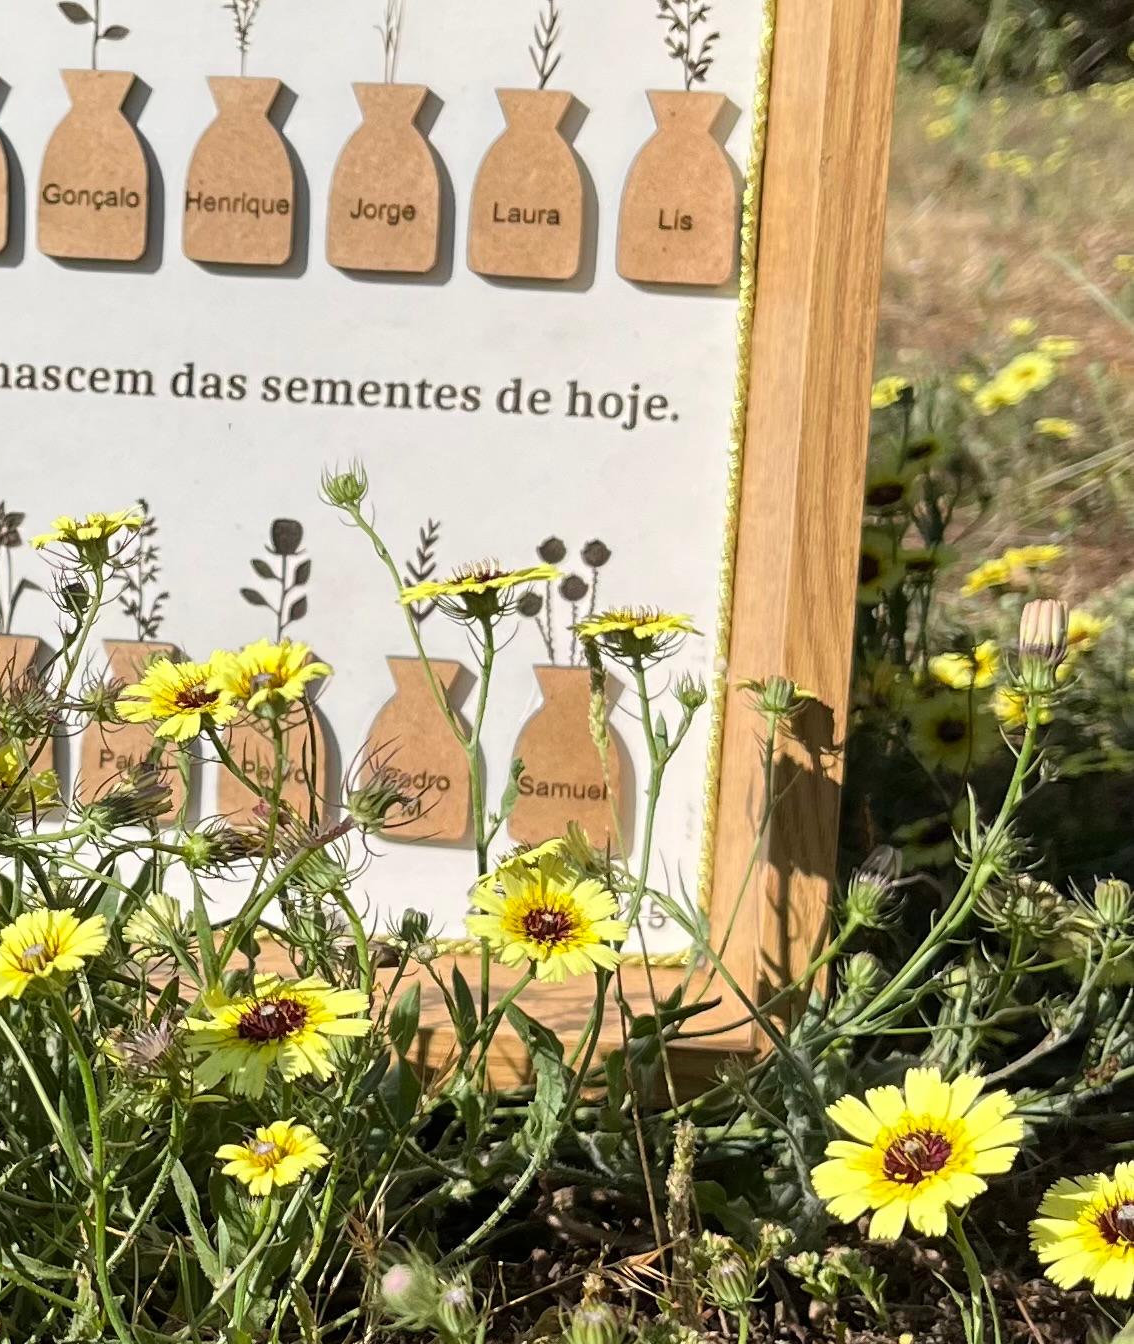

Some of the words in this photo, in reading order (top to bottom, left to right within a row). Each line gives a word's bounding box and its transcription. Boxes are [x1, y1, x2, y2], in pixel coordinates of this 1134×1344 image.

[41, 182, 140, 212] Gonçalo
[184, 190, 290, 219] Henrique
[349, 196, 417, 225] Jorge
[492, 202, 560, 227] Laura
[657, 208, 693, 232] Lis
[171, 362, 247, 400] das
[261, 373, 481, 413] sementes
[495, 378, 551, 416] de
[564, 380, 680, 431] hoje.
[517, 775, 608, 801] Samuel
